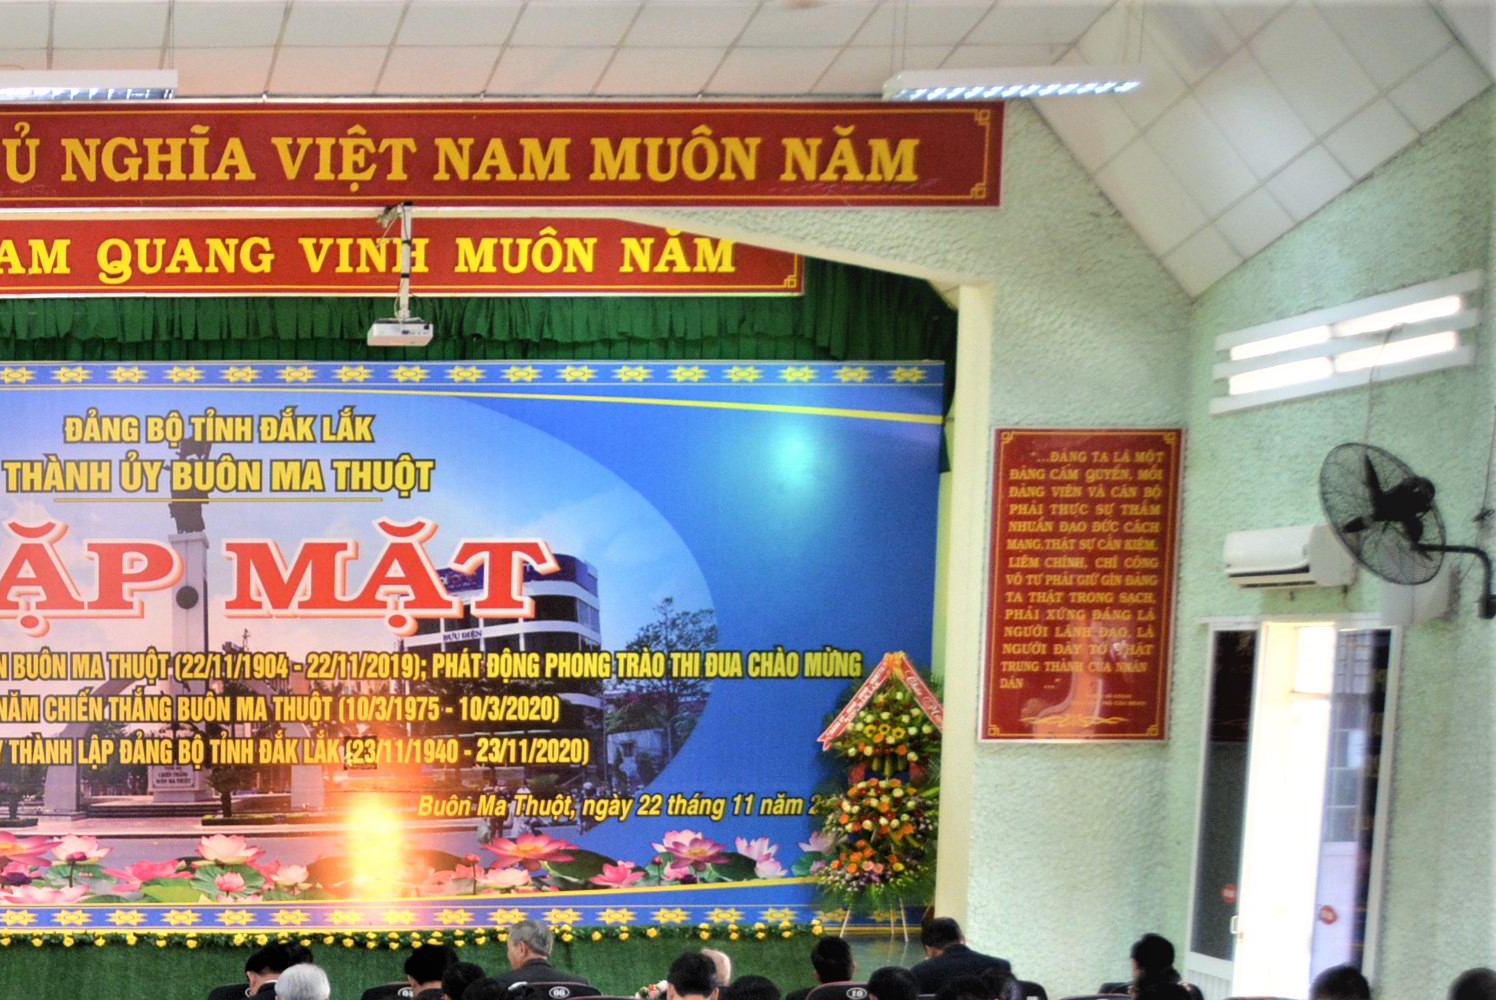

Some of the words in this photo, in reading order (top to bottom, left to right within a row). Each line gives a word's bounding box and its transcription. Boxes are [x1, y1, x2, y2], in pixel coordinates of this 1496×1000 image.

[62, 126, 256, 181] NGHĨA
[271, 123, 418, 192] VIỆT
[434, 138, 571, 180] NAM
[590, 125, 761, 181] MUÔN
[780, 126, 919, 182] NĂM
[99, 237, 274, 283] QUANG
[299, 237, 429, 273] VINH
[455, 226, 597, 274] MUÔN
[621, 228, 736, 273] NĂM
[65, 409, 140, 443] ĐẢNG
[147, 411, 184, 448] BỘ
[191, 408, 253, 443] TỈNH
[259, 406, 316, 443] ĐẮK
[322, 407, 374, 443] LẮK
[3, 455, 112, 493] THÀNH
[121, 450, 164, 492] ỦY
[172, 453, 262, 493] BUÔN
[270, 459, 325, 492] MA
[332, 453, 435, 498] THUỘT
[221, 516, 560, 637] MẶT
[13, 649, 67, 680] BUÔN
[72, 653, 104, 679] MA
[109, 648, 170, 685] THUỘT
[175, 653, 289, 682] (22/11/1904
[306, 652, 427, 682] 22/11/2019);
[432, 647, 483, 679] PHÁT
[486, 647, 540, 684] ĐỘNG
[544, 652, 611, 678] PHONG
[616, 647, 665, 678] TRÀO
[671, 652, 700, 678] THI
[705, 652, 743, 678] ĐUA
[747, 648, 799, 678] CHÀO
[805, 646, 861, 678] MỪNG
[45, 688, 103, 722] CHIẾN
[109, 687, 172, 722] THẮNG
[177, 691, 231, 722] BUÔN
[236, 695, 268, 722] MA
[272, 691, 333, 726] THUỘT
[339, 695, 441, 723] (10/3/1975
[459, 695, 560, 724] 10/3/2020)
[9, 733, 73, 765] THÀNH
[77, 733, 115, 769] LẬP
[118, 731, 173, 765] ĐẢNG
[178, 734, 205, 770] BỘ
[209, 731, 255, 765] TỈNH
[259, 731, 298, 764] ĐẮK
[304, 735, 340, 764] LẮK
[344, 738, 460, 767] (23/11/1940
[476, 737, 590, 766] 23/11/2020)
[417, 795, 472, 817] Buôn
[477, 794, 508, 817] Ma
[513, 793, 576, 821] Thuột,
[582, 794, 633, 823] ngày
[637, 794, 662, 818] 22
[667, 793, 727, 822] tháng
[732, 794, 755, 815] 11
[759, 793, 805, 816] năm
